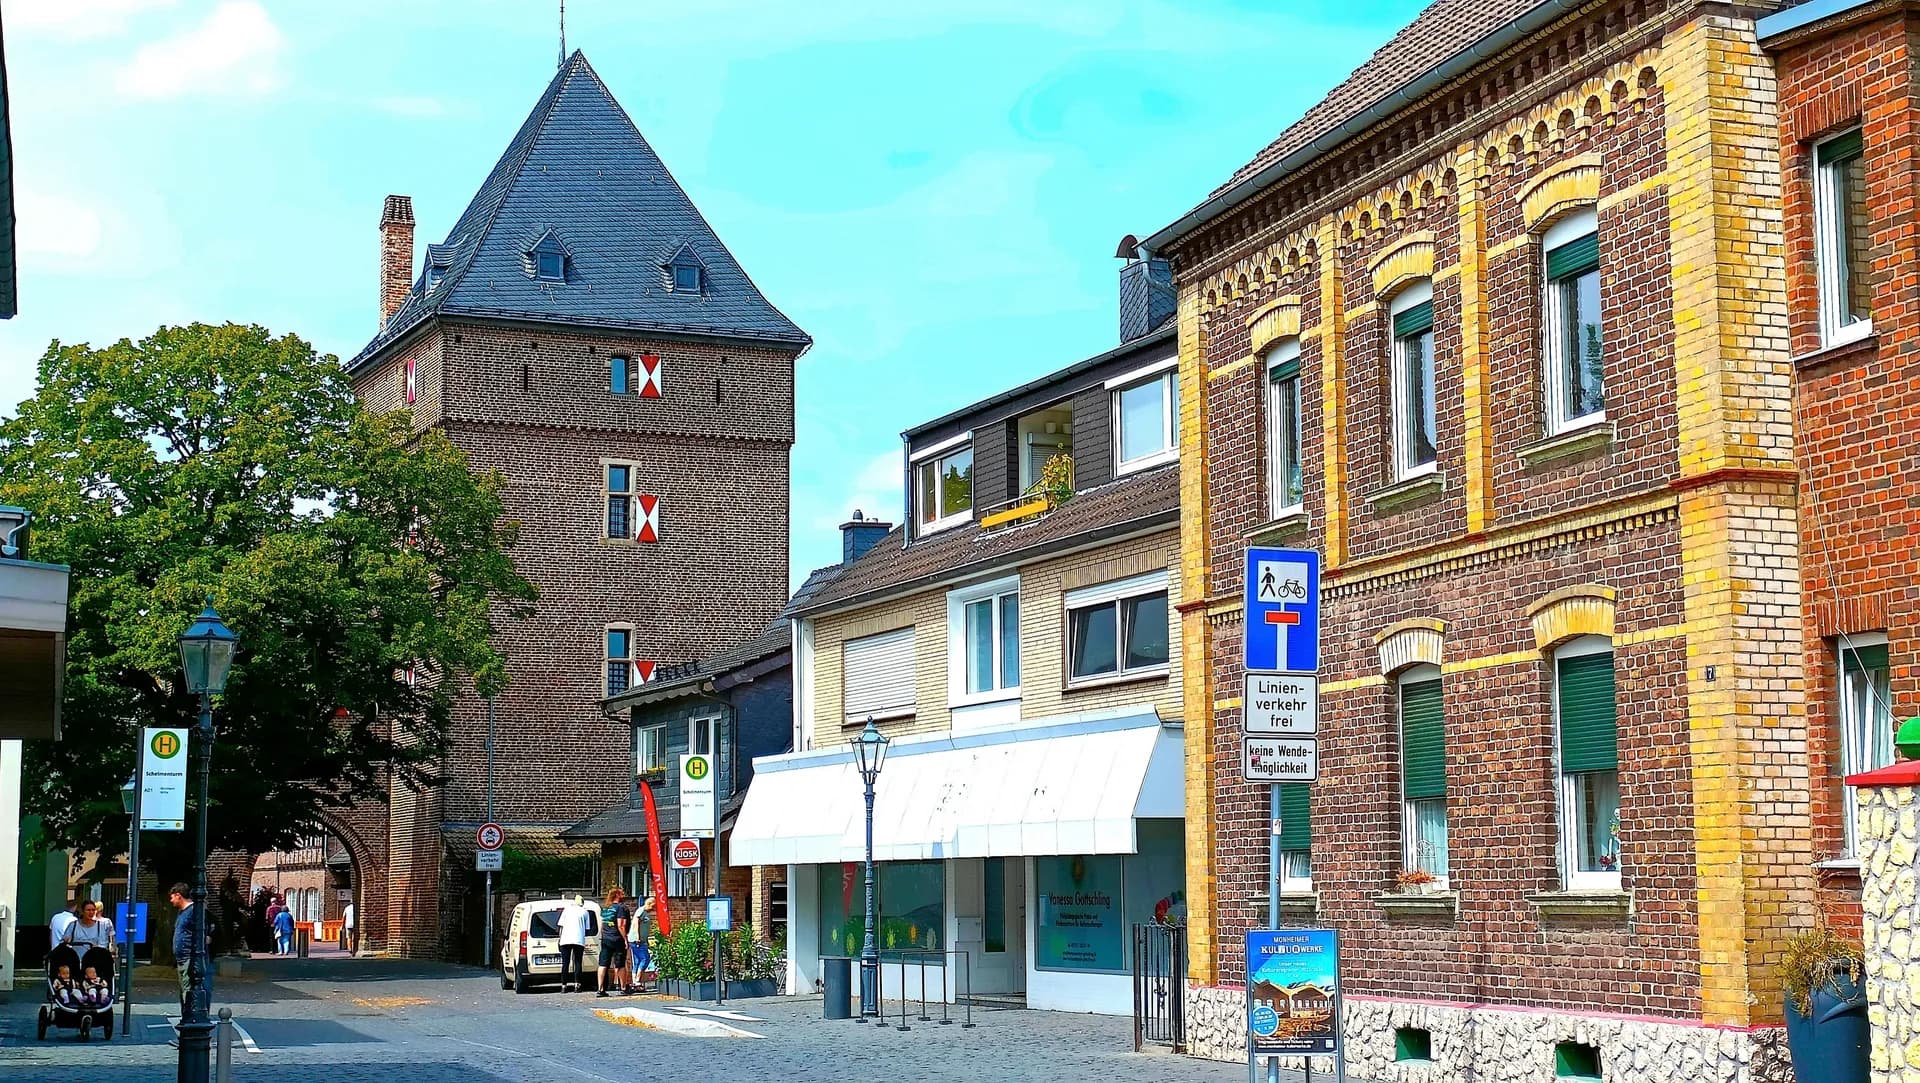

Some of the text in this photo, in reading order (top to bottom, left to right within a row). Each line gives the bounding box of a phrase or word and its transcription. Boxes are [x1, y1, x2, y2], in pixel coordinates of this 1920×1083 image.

[1258, 681, 1304, 694] Linien-
[1256, 698, 1307, 711] verkehr
[1271, 715, 1293, 727] frei
[160, 737, 172, 753] H
[1249, 745, 1312, 757] keine Wende-
[692, 762, 702, 774] H
[675, 849, 698, 858] KIOSK
[1049, 891, 1073, 906] Vanessa
